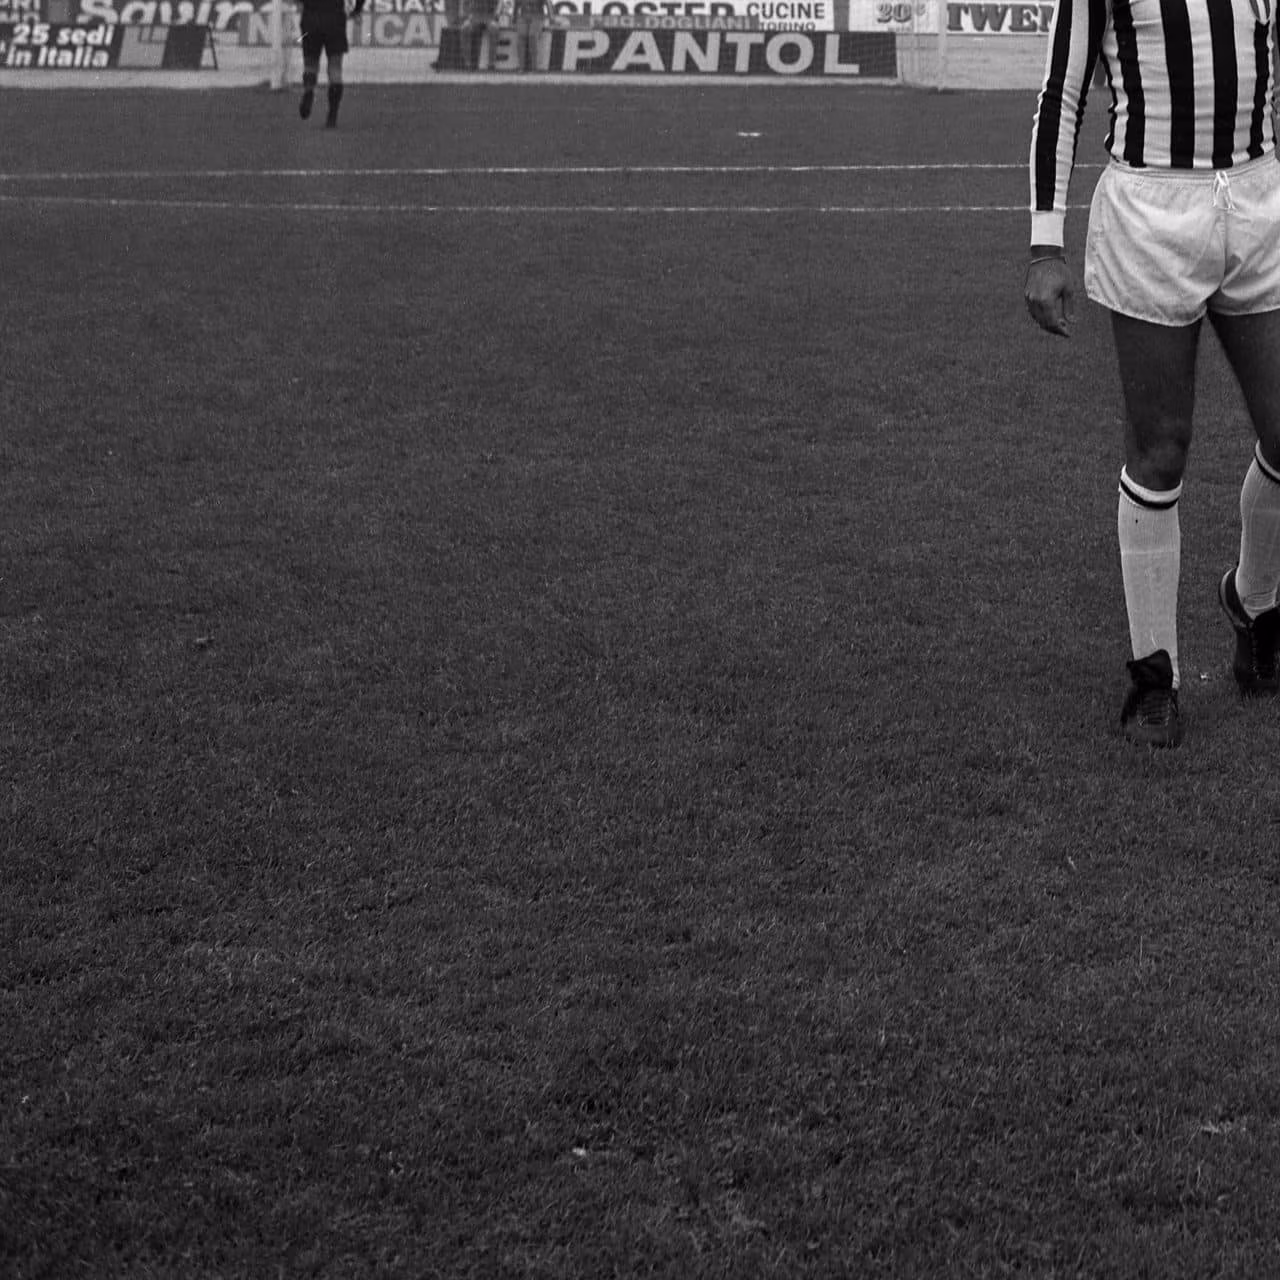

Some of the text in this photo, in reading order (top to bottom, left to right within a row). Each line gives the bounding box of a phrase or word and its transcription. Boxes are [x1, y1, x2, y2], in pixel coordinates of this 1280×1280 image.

[746, 1, 826, 20] CUCINE
[12, 23, 115, 46] 25 sedi
[37, 45, 110, 68] Italia
